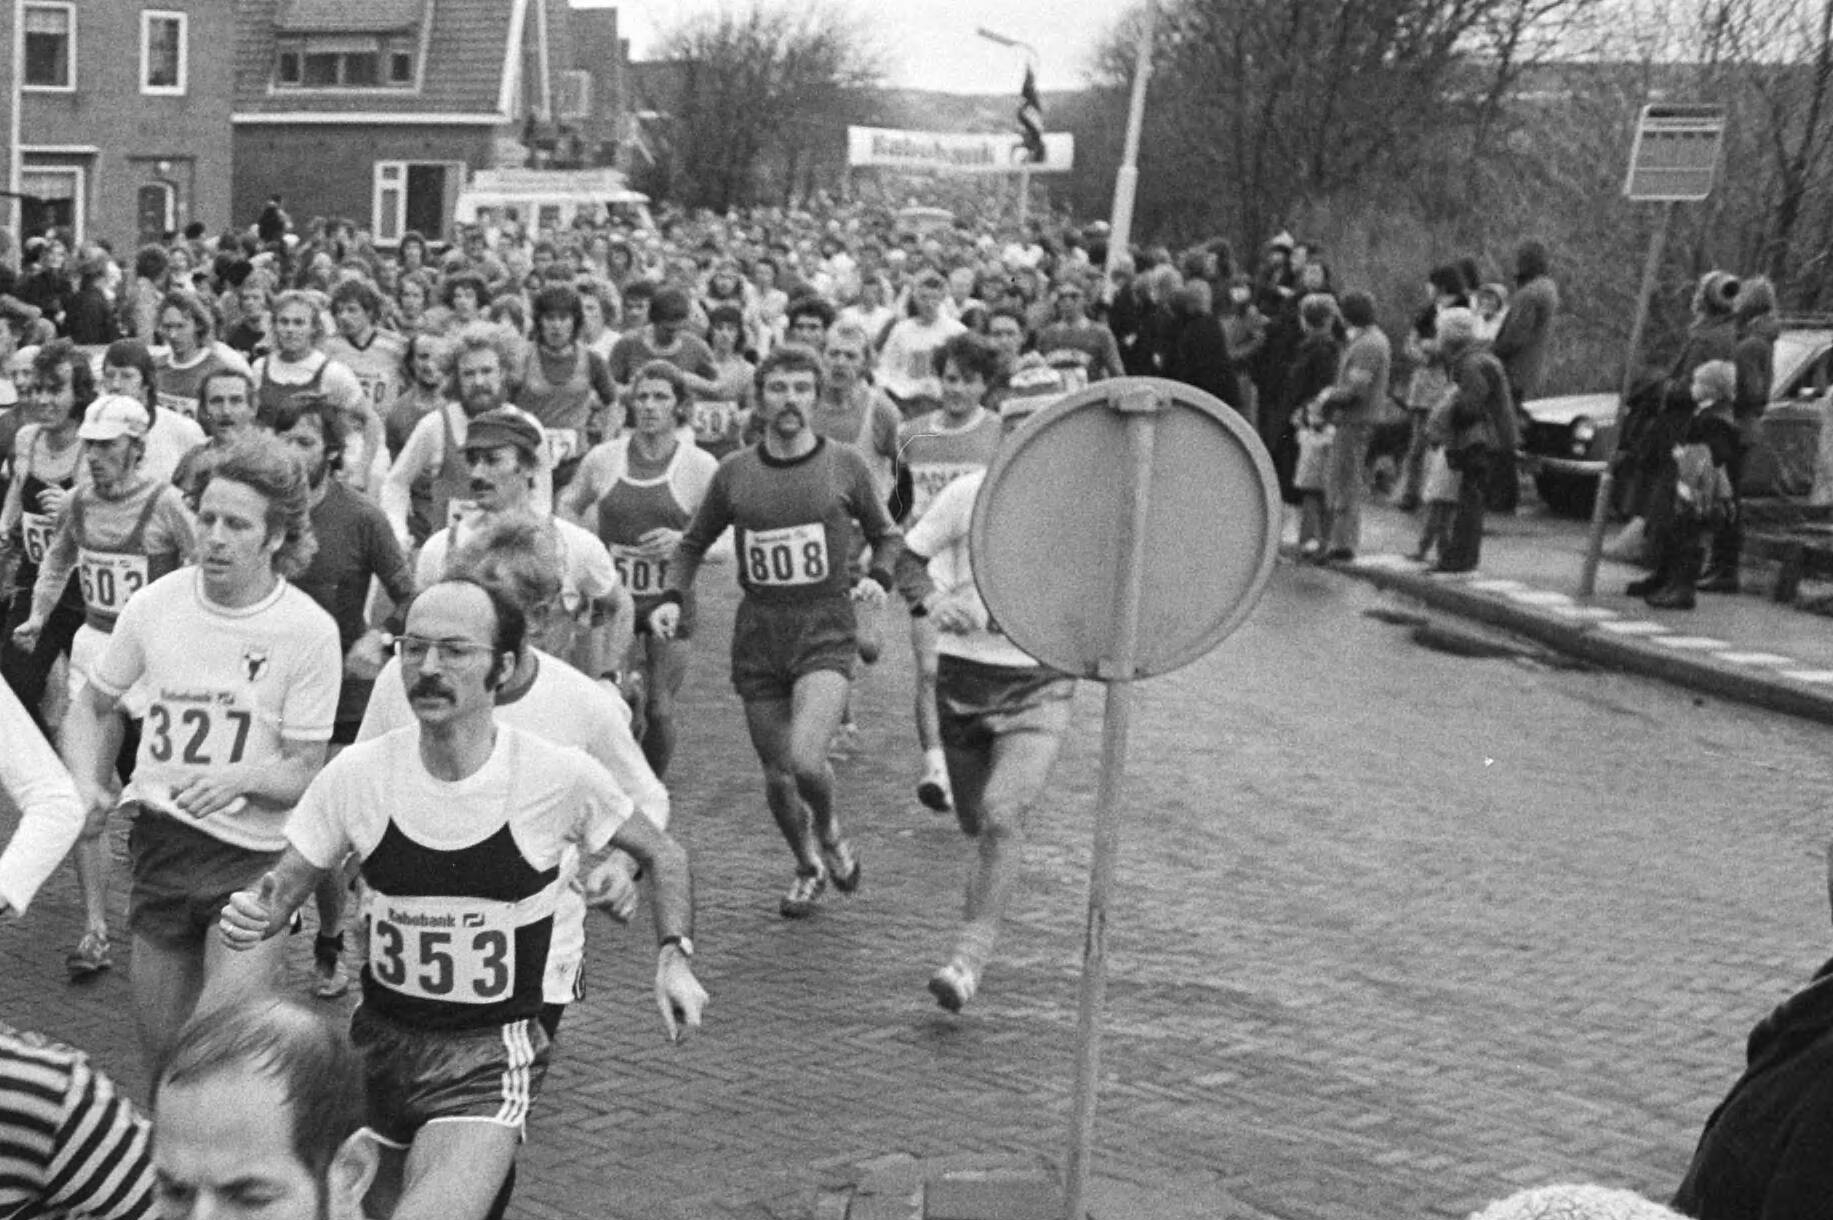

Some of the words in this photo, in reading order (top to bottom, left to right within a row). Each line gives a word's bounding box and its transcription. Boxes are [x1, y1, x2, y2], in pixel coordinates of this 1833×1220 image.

[750, 541, 824, 581] 808
[149, 704, 251, 765] 327
[388, 907, 456, 927] Rabobank
[376, 919, 509, 998] 353
